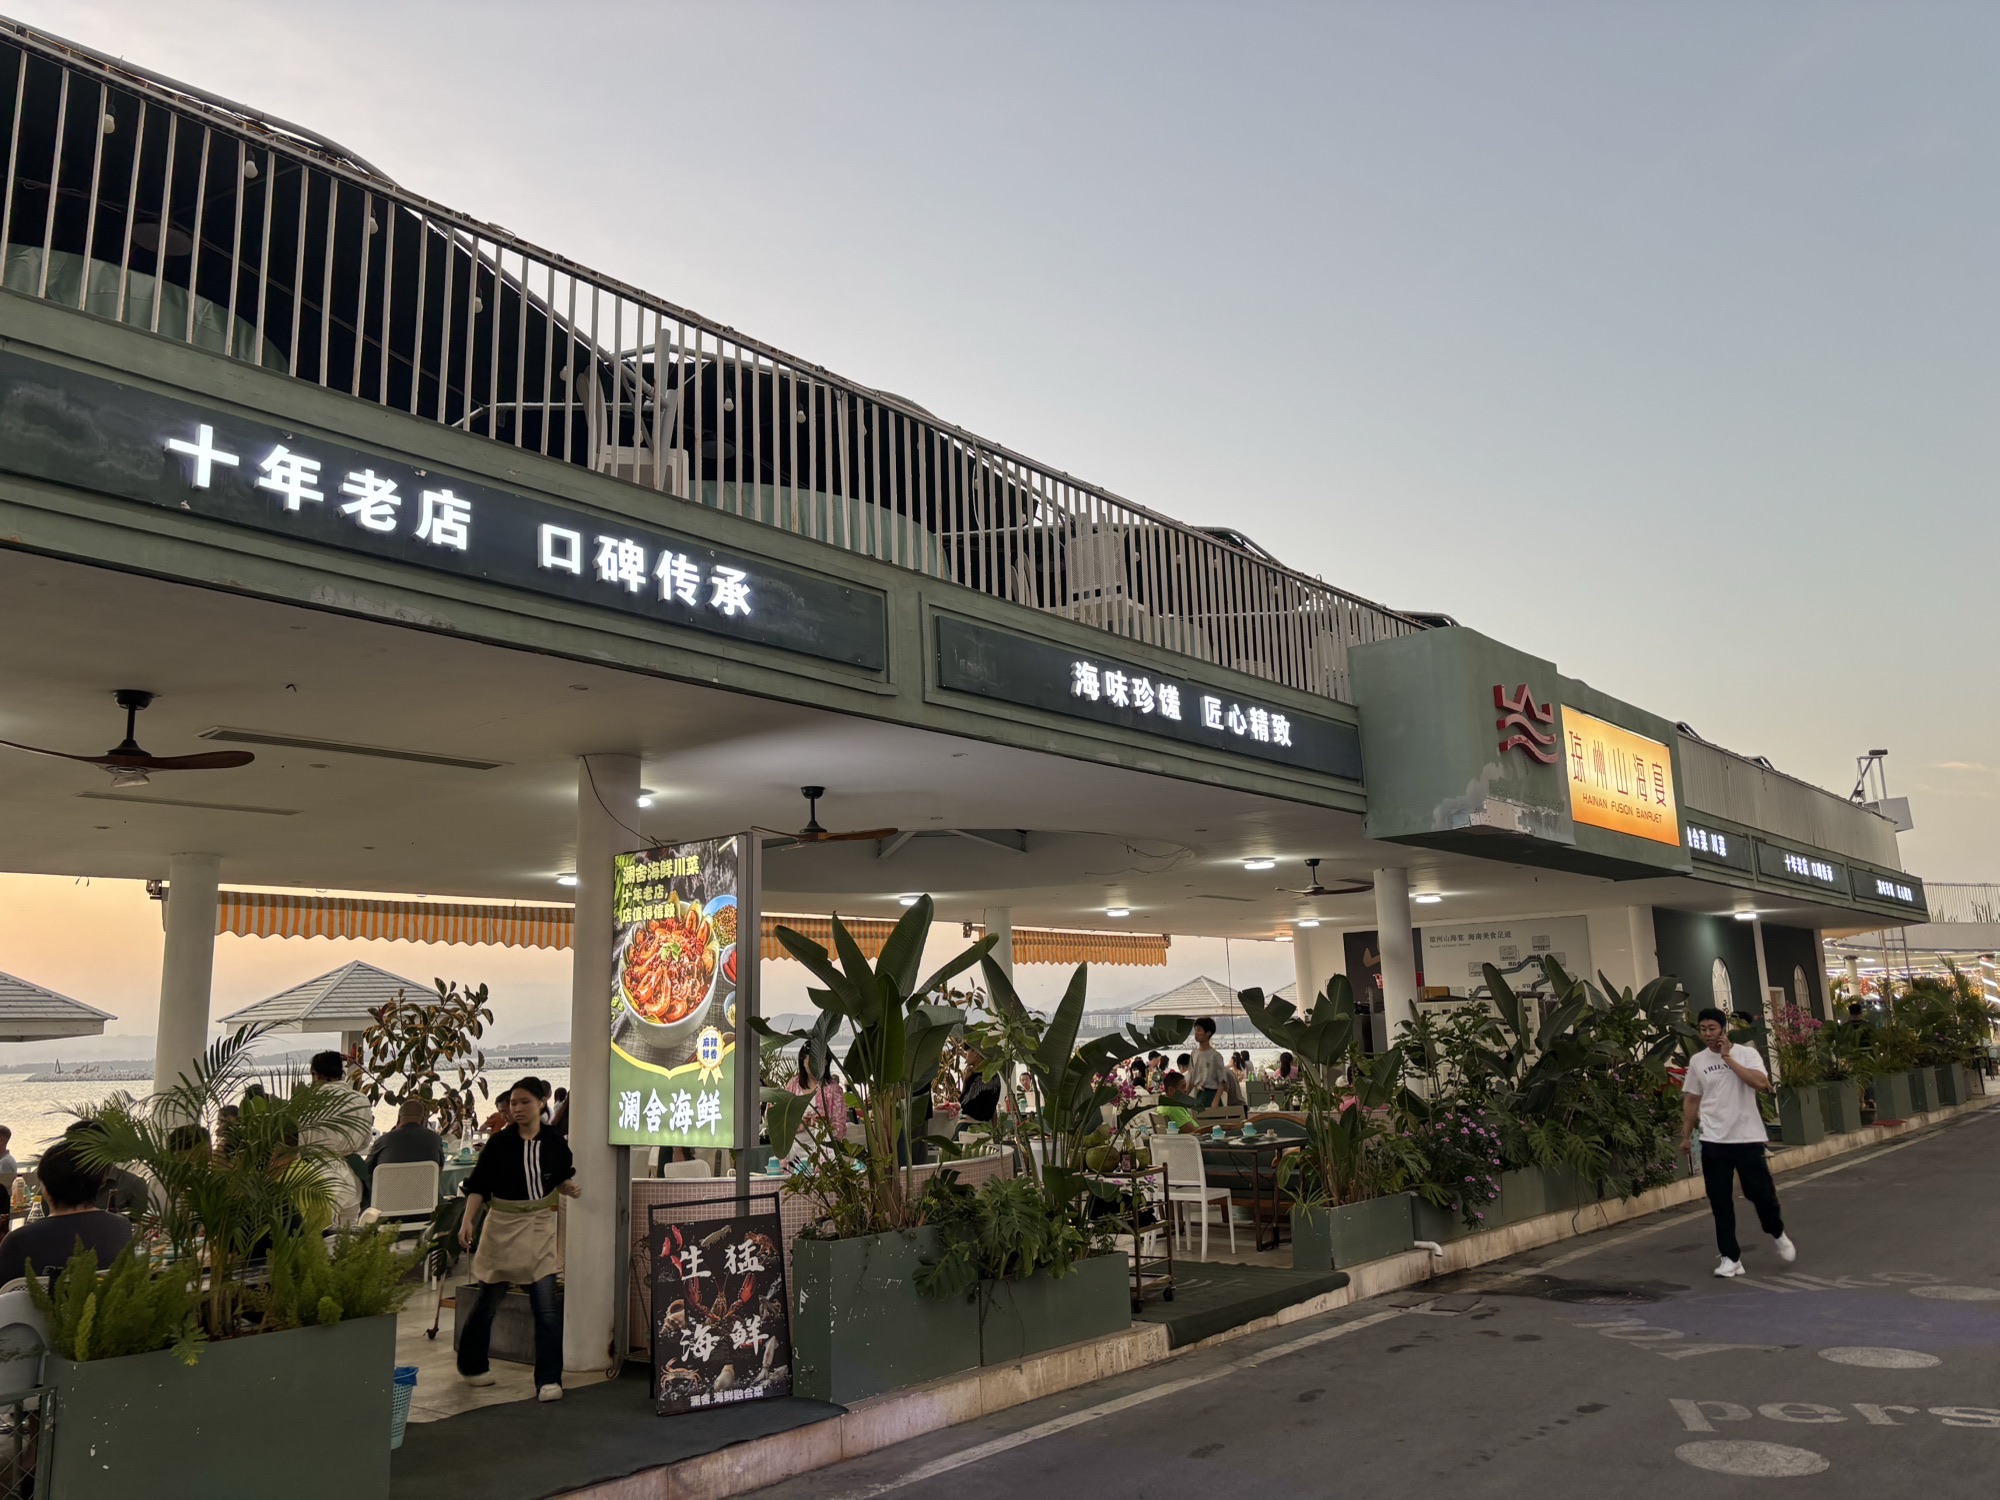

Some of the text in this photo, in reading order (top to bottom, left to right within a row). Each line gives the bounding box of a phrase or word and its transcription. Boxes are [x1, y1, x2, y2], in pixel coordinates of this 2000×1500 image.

[164, 423, 755, 618] 十年老店 口碑传承
[1072, 661, 1293, 748] 海味珍馐 匠心精致
[1582, 793, 1608, 809] HAINAN
[1611, 801, 1634, 816] FUSION
[622, 855, 700, 885] 澜舍海鲜川菜
[622, 902, 676, 923] 店值得信赖
[1703, 1063, 1733, 1075] FRIEN
[617, 1087, 723, 1136] 澜舍海鲜
[681, 1238, 766, 1281] 生猛
[681, 1313, 770, 1363] 海鲜
